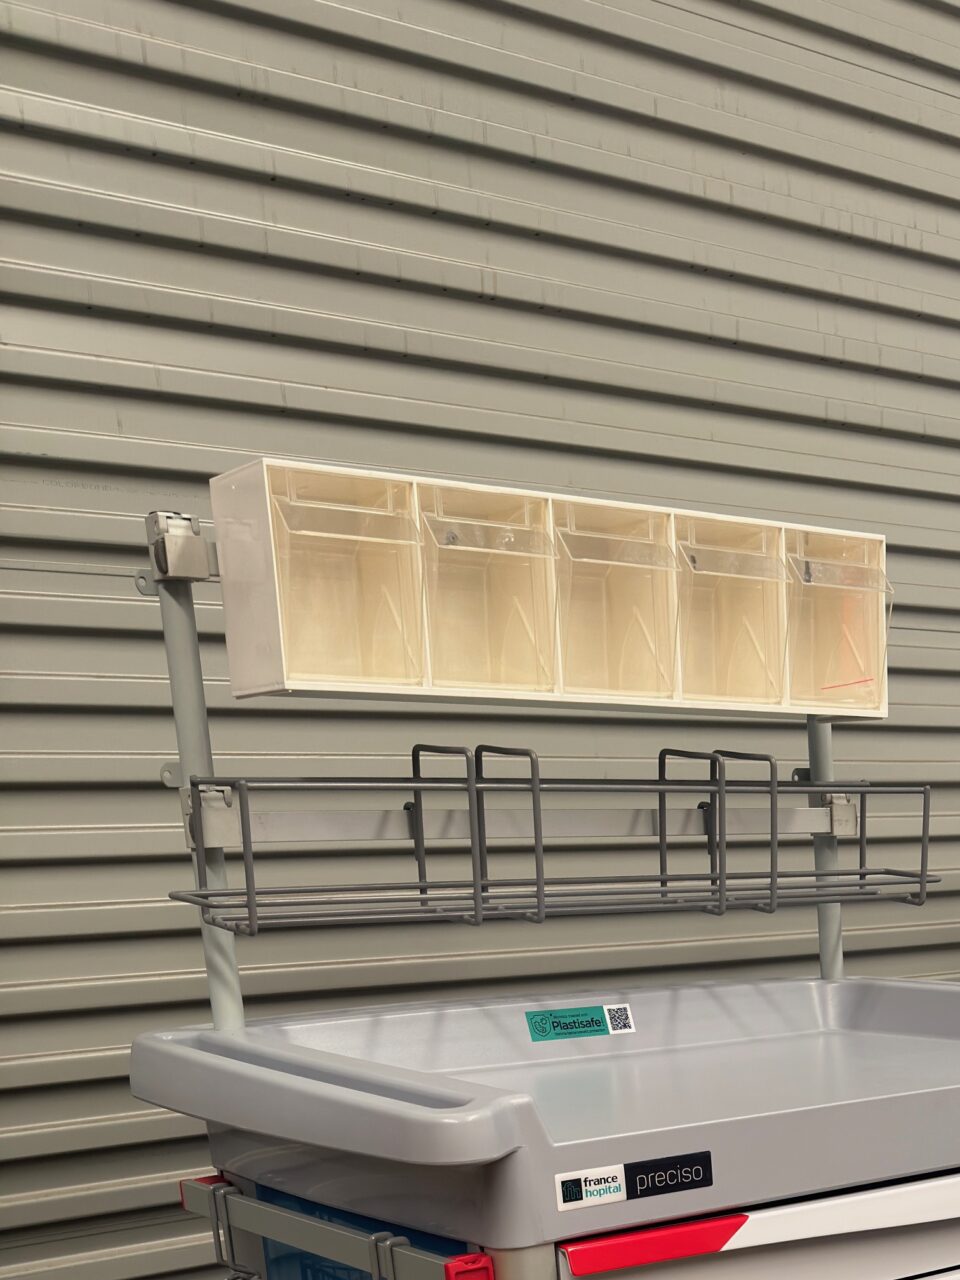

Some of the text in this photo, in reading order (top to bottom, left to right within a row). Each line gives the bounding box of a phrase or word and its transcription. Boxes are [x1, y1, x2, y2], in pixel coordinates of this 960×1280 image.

[583, 1175, 618, 1187] france
[636, 1165, 703, 1195] preciso
[585, 1184, 622, 1198] hopital
